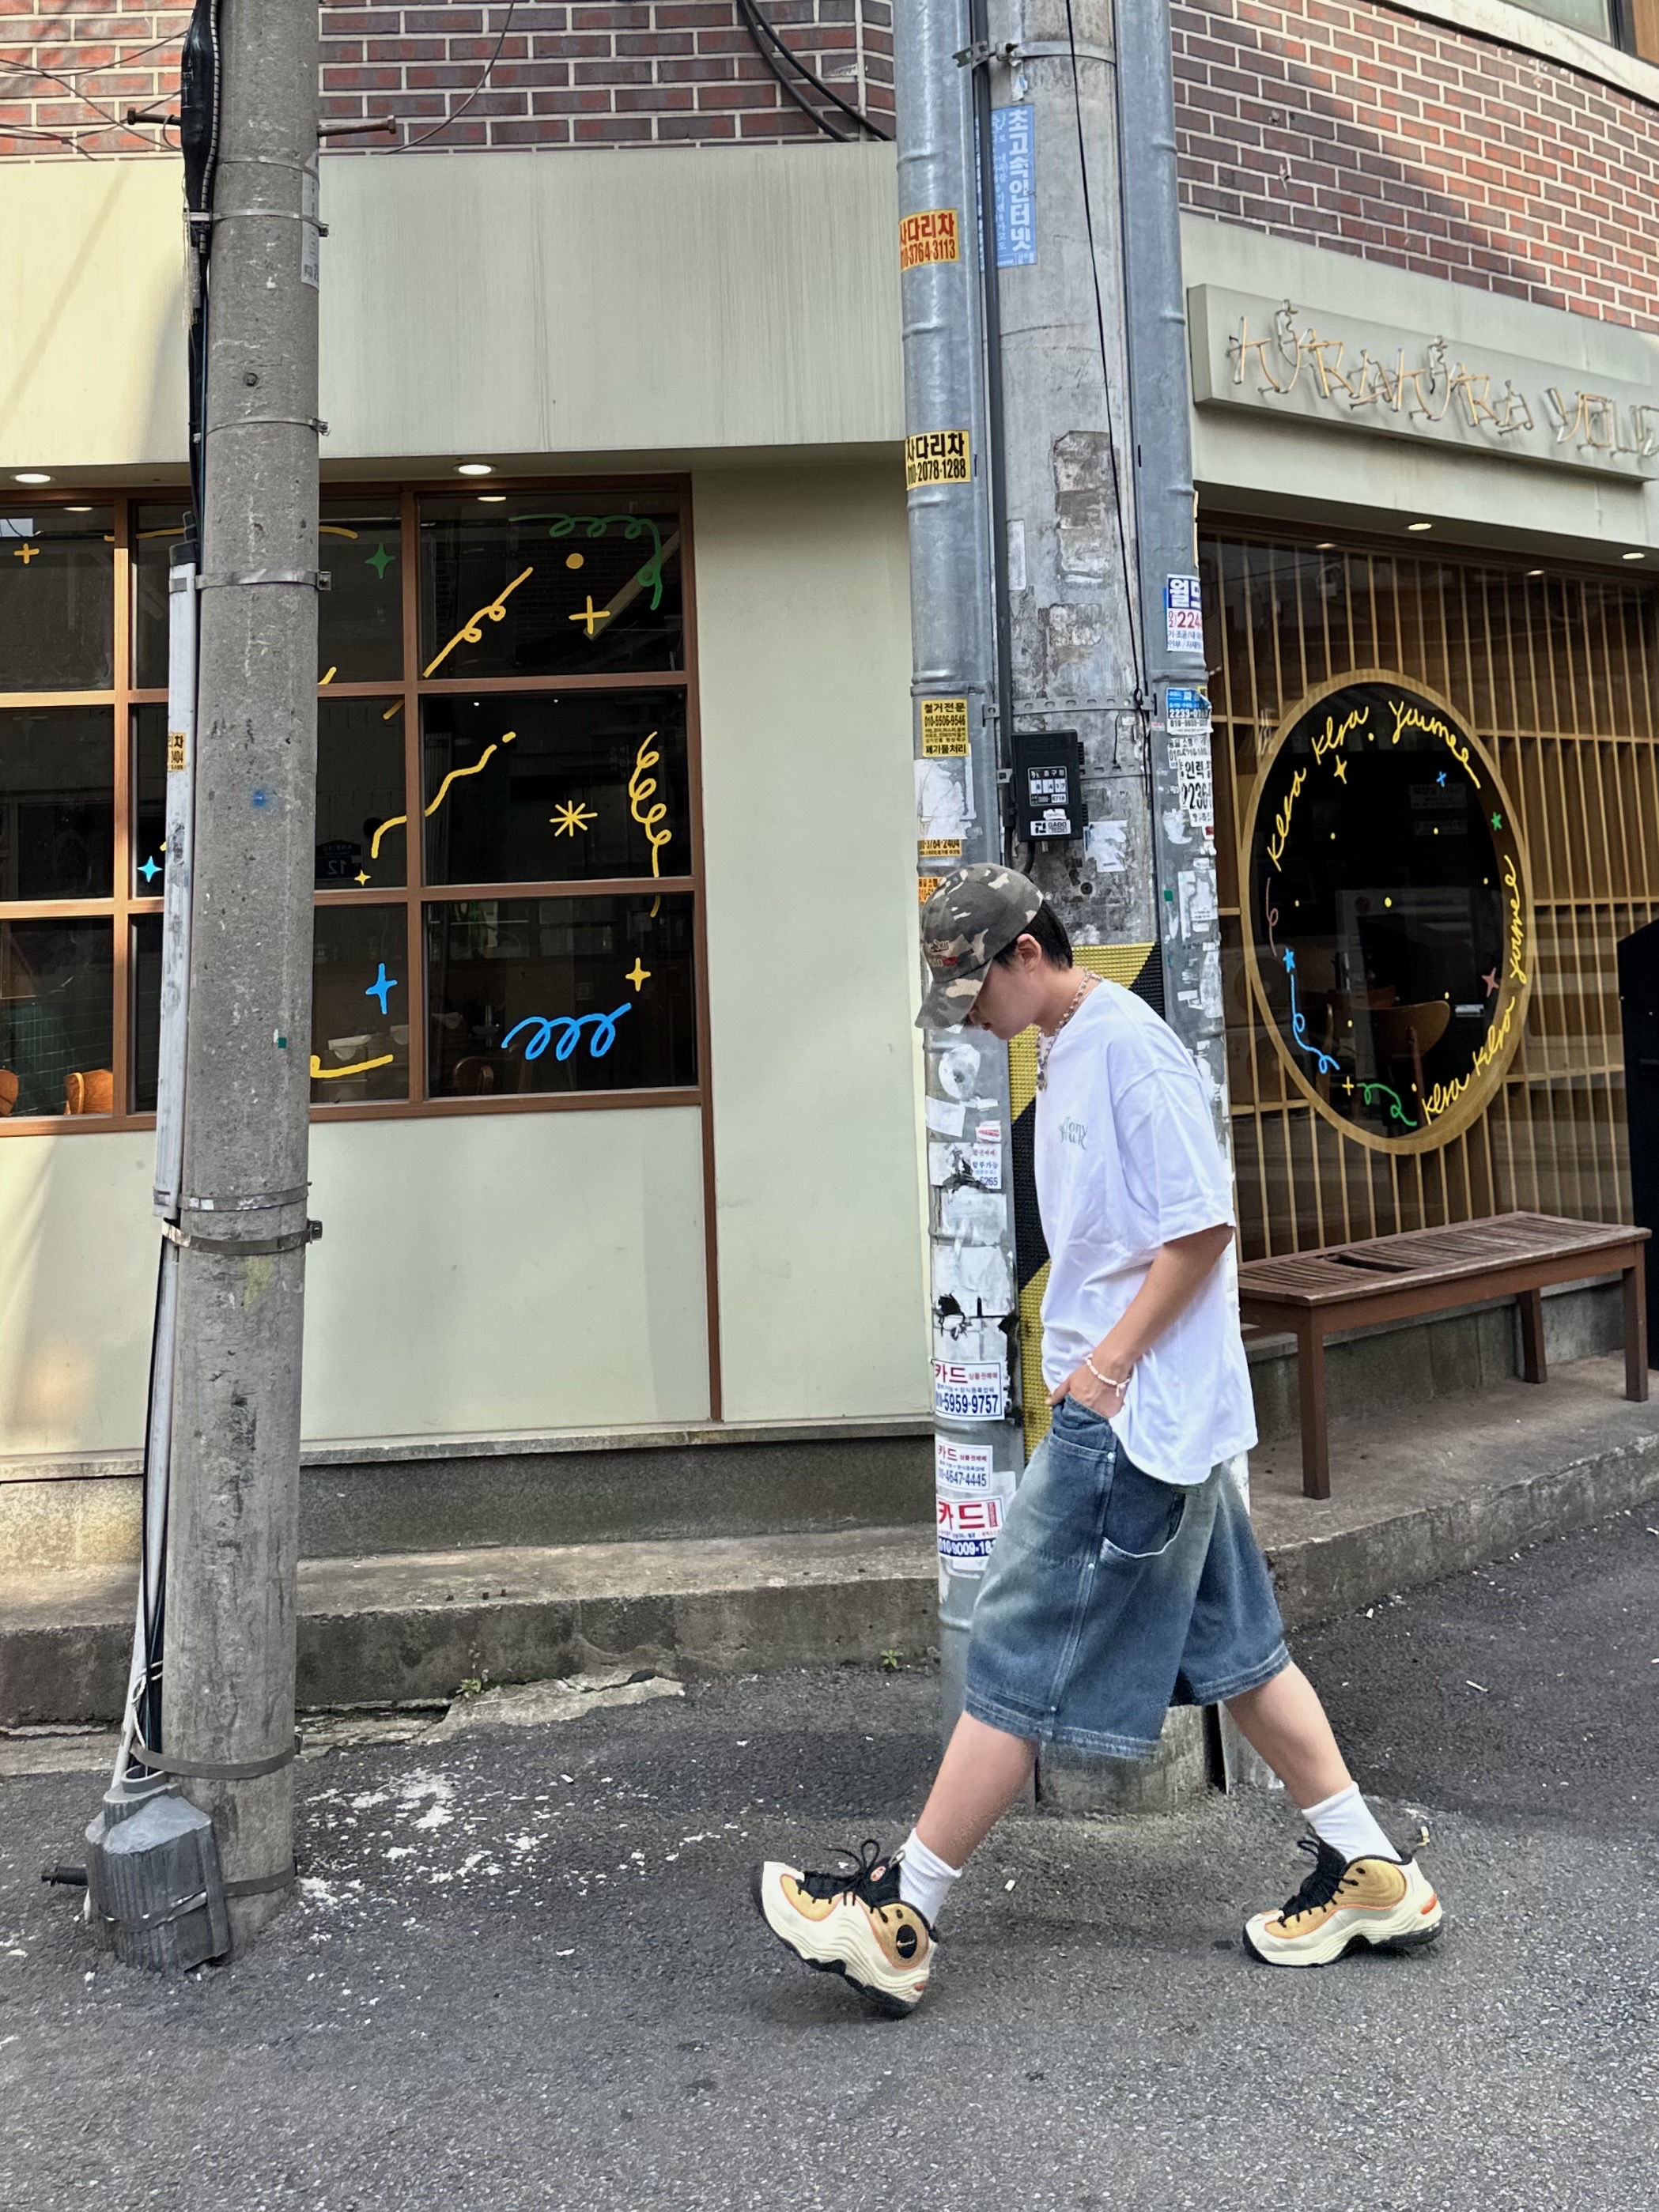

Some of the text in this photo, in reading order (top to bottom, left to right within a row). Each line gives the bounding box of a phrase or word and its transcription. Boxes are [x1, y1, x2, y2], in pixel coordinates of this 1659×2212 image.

[1009, 109, 1032, 252] 초고속인터넷
[907, 432, 965, 462] 사다리차
[924, 702, 966, 714] 철거전문
[926, 744, 966, 754] 폐기물처리
[935, 1364, 968, 1384] 카드
[939, 1444, 958, 1462] 카드
[939, 1500, 985, 1531] 카드
